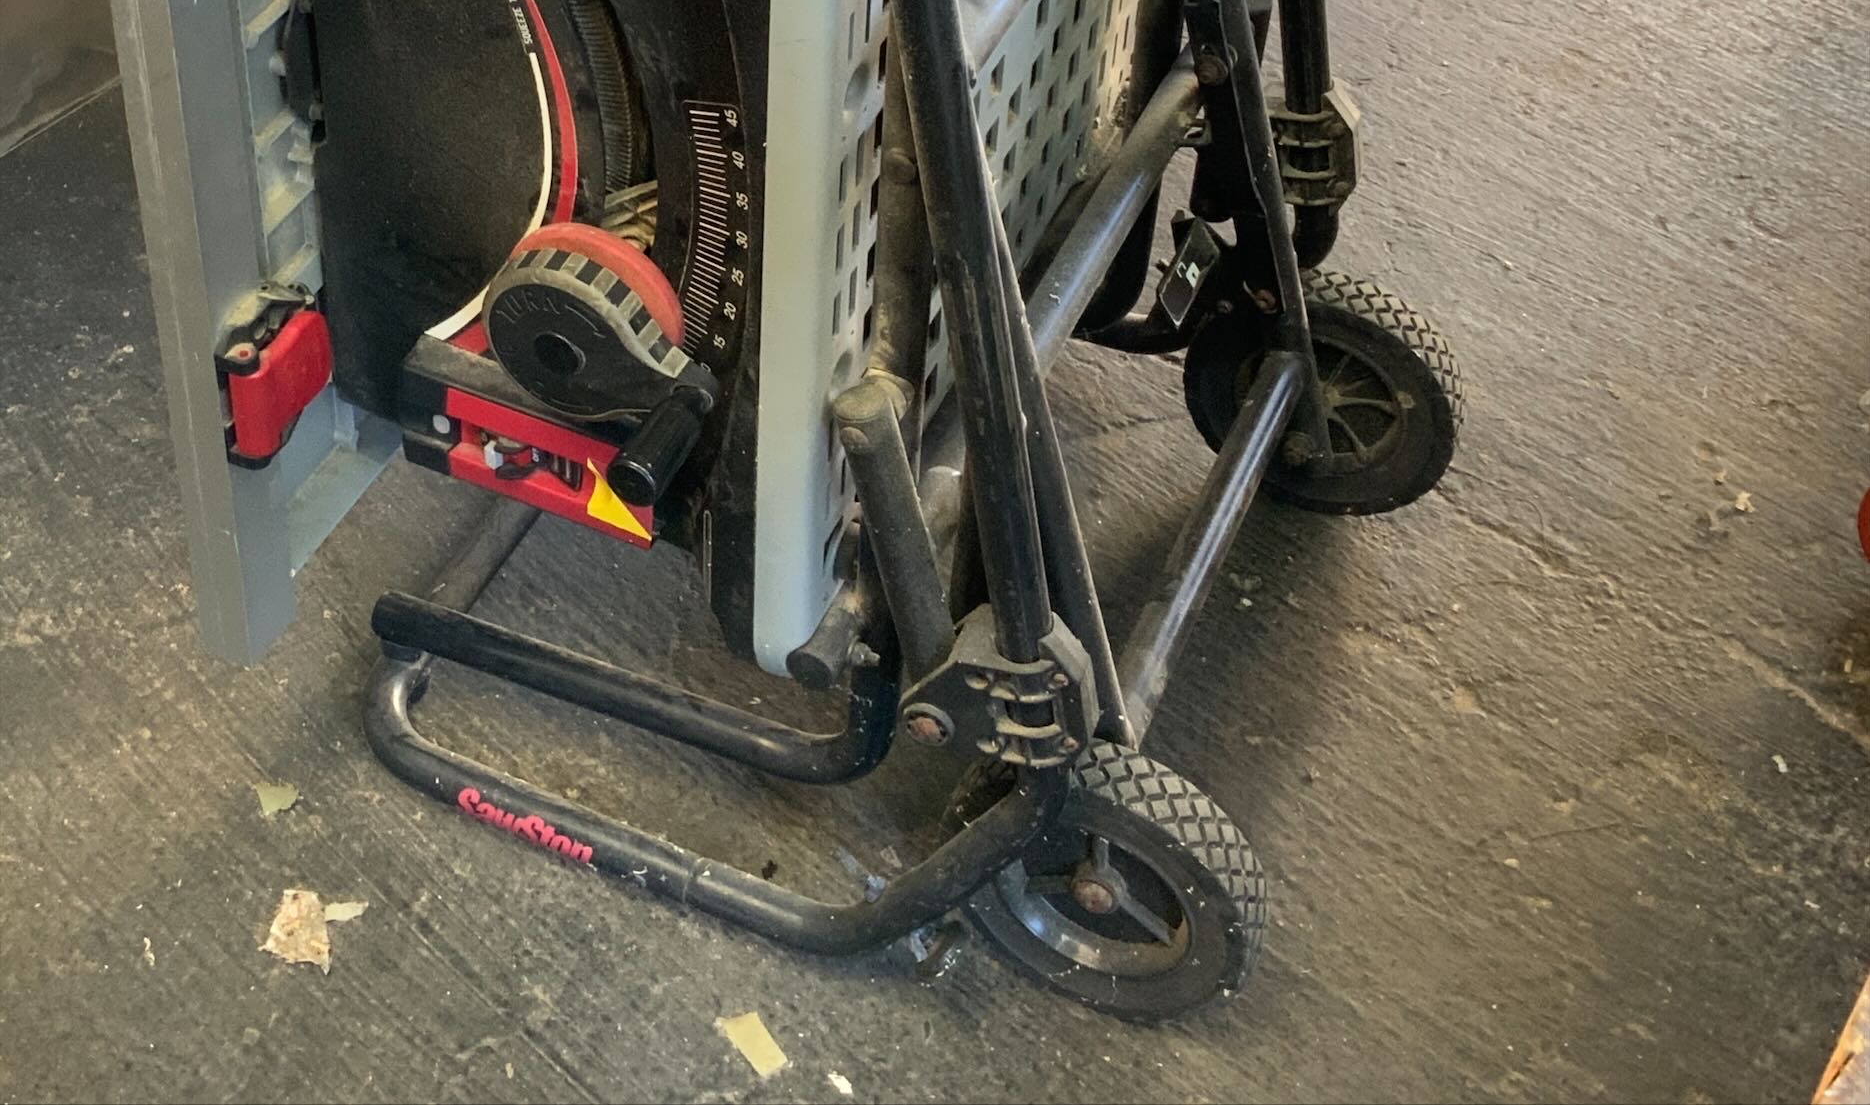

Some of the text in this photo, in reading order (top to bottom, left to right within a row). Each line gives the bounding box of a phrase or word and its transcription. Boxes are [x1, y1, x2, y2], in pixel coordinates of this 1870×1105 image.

[512, 7, 533, 44] SQUEEZE
[724, 109, 739, 128] 45
[732, 151, 745, 170] 40
[736, 192, 749, 210] 35
[736, 231, 749, 249] 30
[731, 268, 745, 286] 25
[723, 301, 737, 321] 20
[713, 334, 726, 350] 15
[457, 787, 593, 863] SawStop
